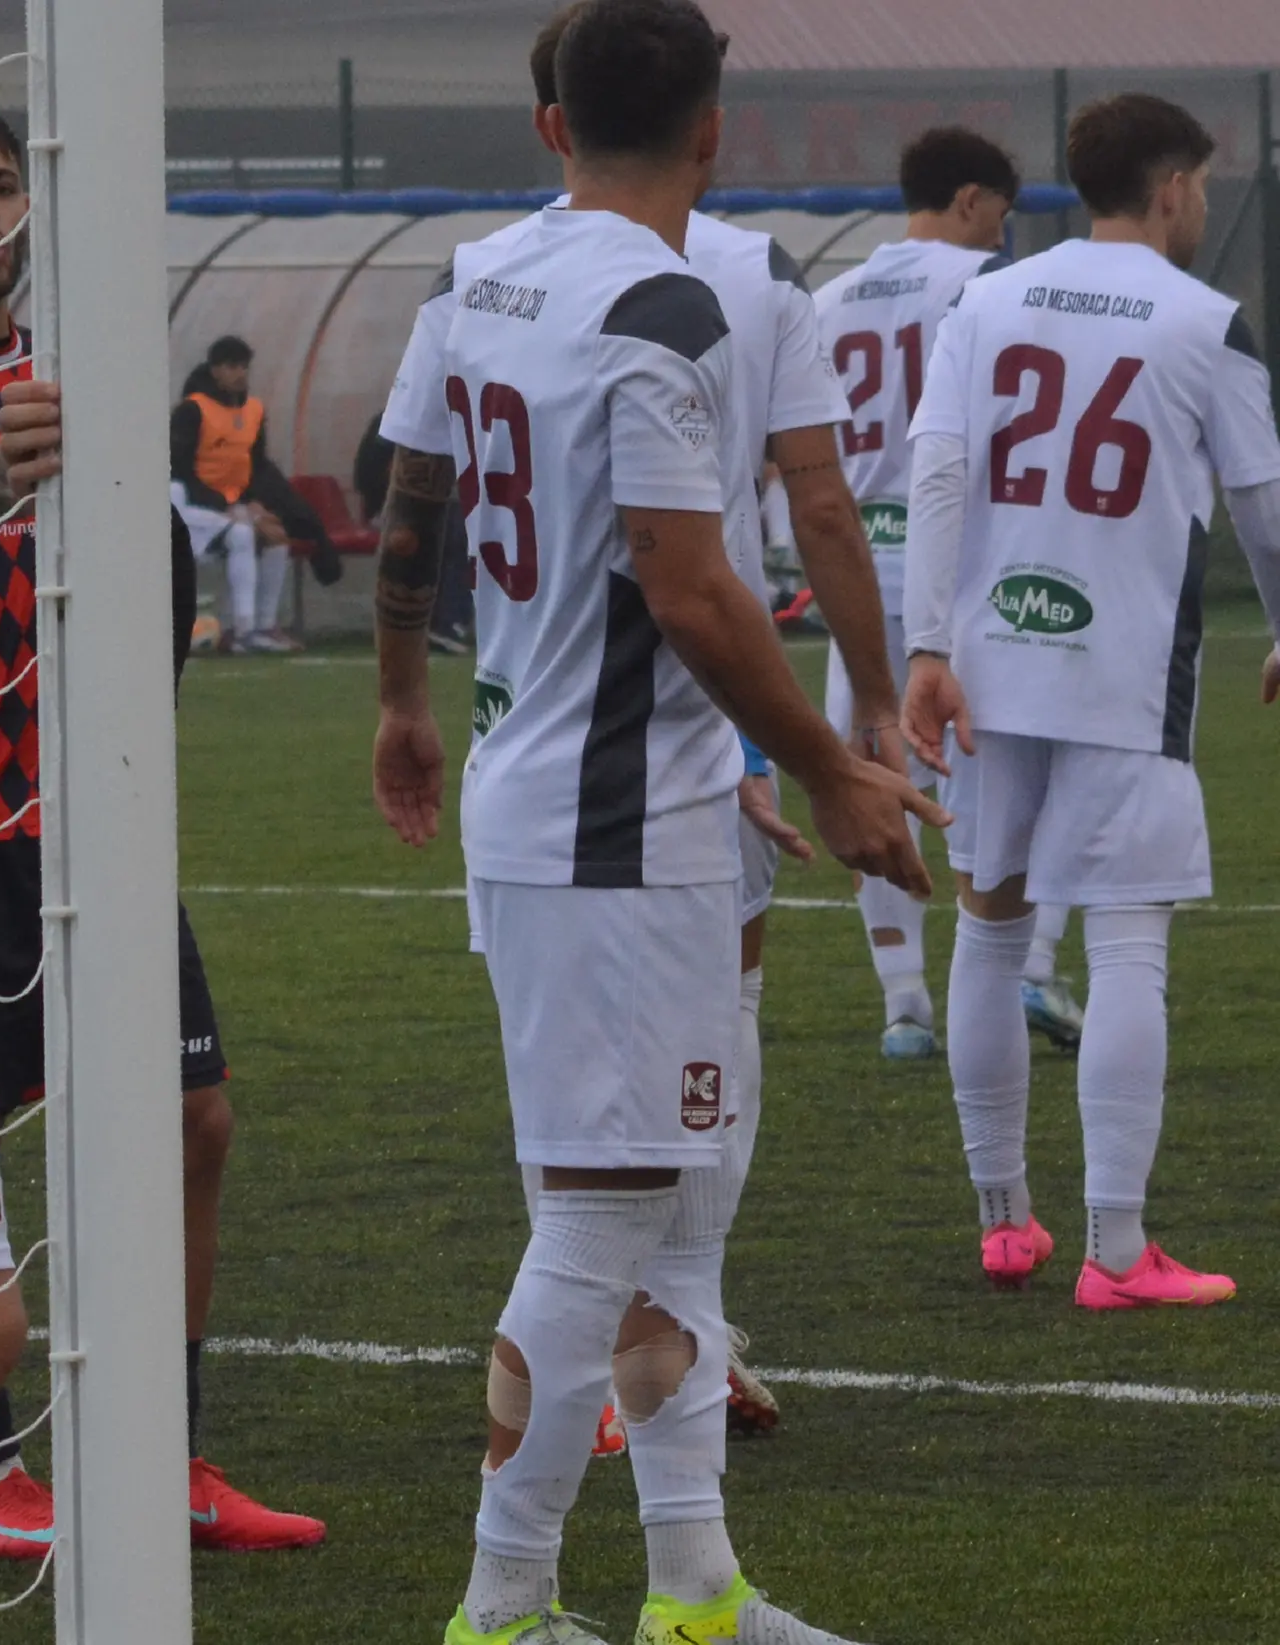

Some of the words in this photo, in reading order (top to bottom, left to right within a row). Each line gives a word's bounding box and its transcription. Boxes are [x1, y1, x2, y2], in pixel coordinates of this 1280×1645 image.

[1022, 287, 1046, 308] ASD
[1047, 288, 1111, 317] MESORACA
[1110, 296, 1155, 321] CALCIO
[833, 322, 922, 456] 21
[990, 344, 1151, 519] 26
